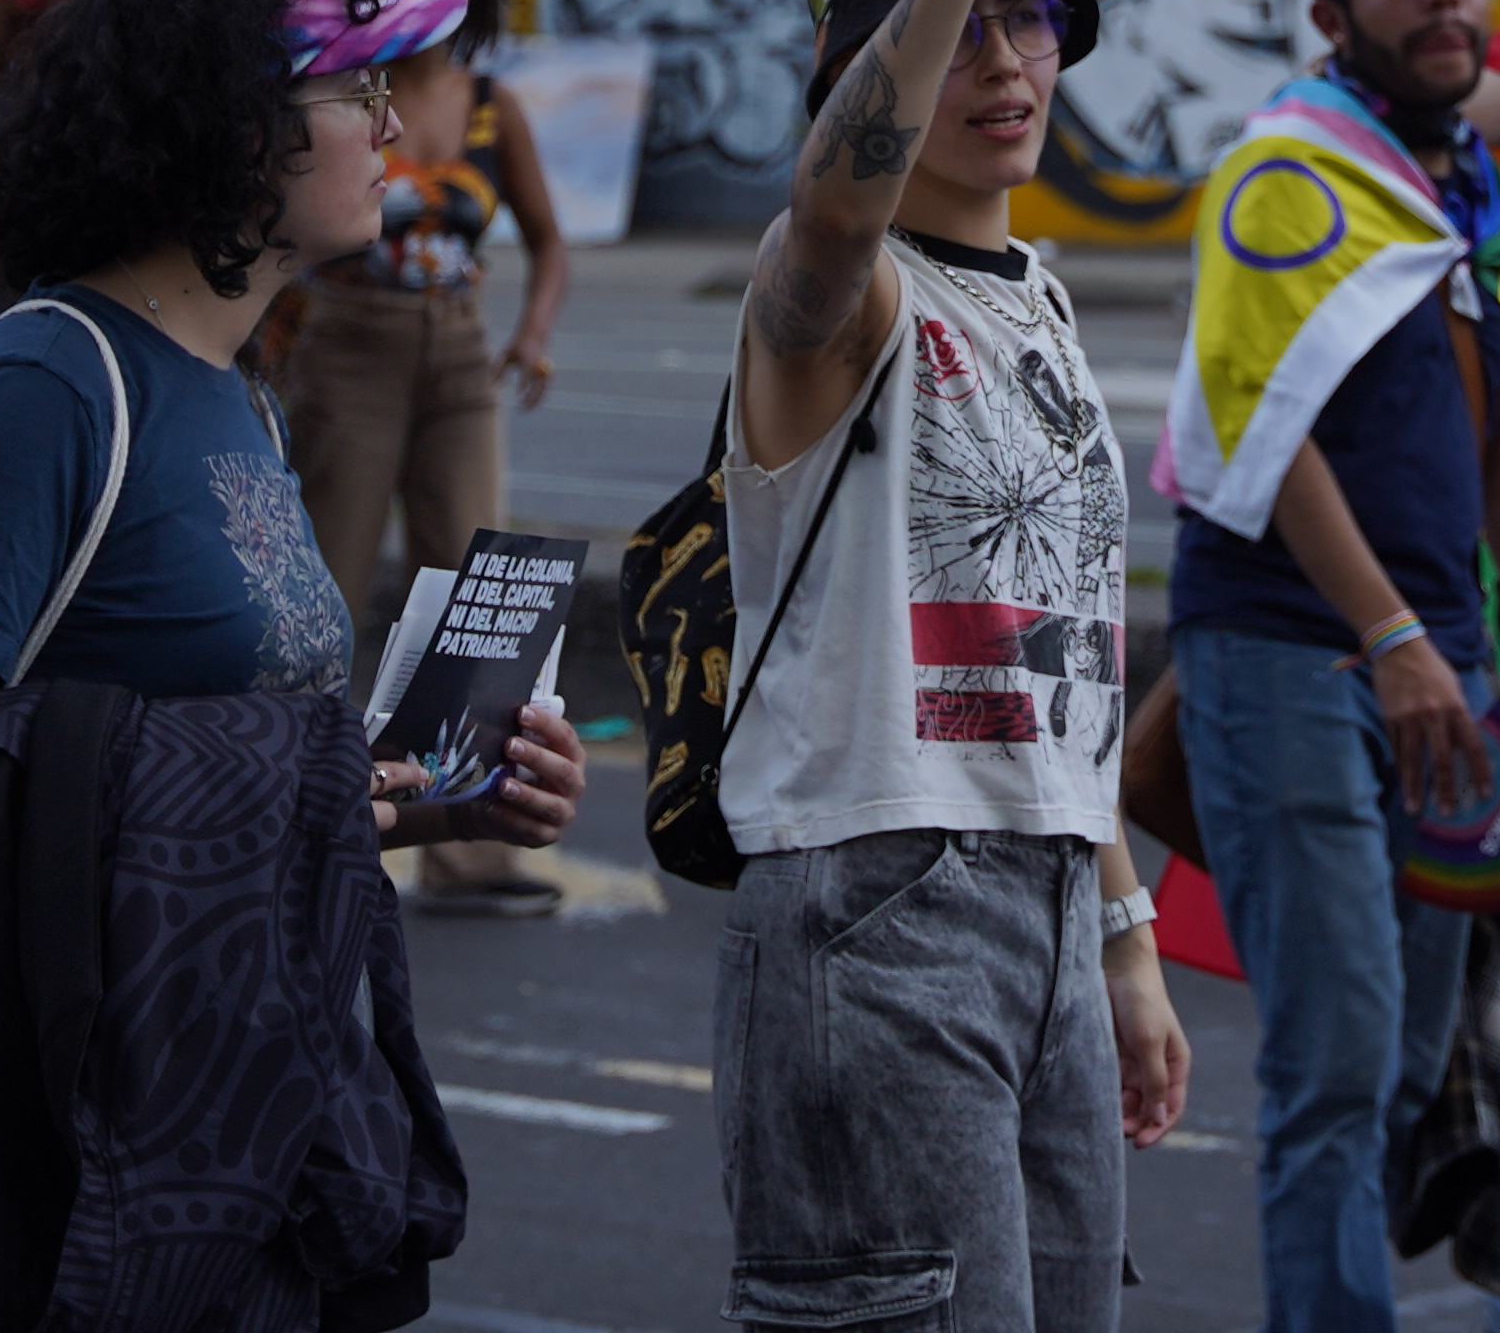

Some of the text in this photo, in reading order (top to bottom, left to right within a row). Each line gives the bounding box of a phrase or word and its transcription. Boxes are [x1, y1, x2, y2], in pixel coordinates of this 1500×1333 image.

[468, 551, 489, 576] NI
[484, 553, 510, 579] DE
[505, 556, 526, 581] LA
[456, 578, 478, 602] NI
[474, 580, 503, 606] DEL
[446, 603, 539, 634] NI DEL MACHO
